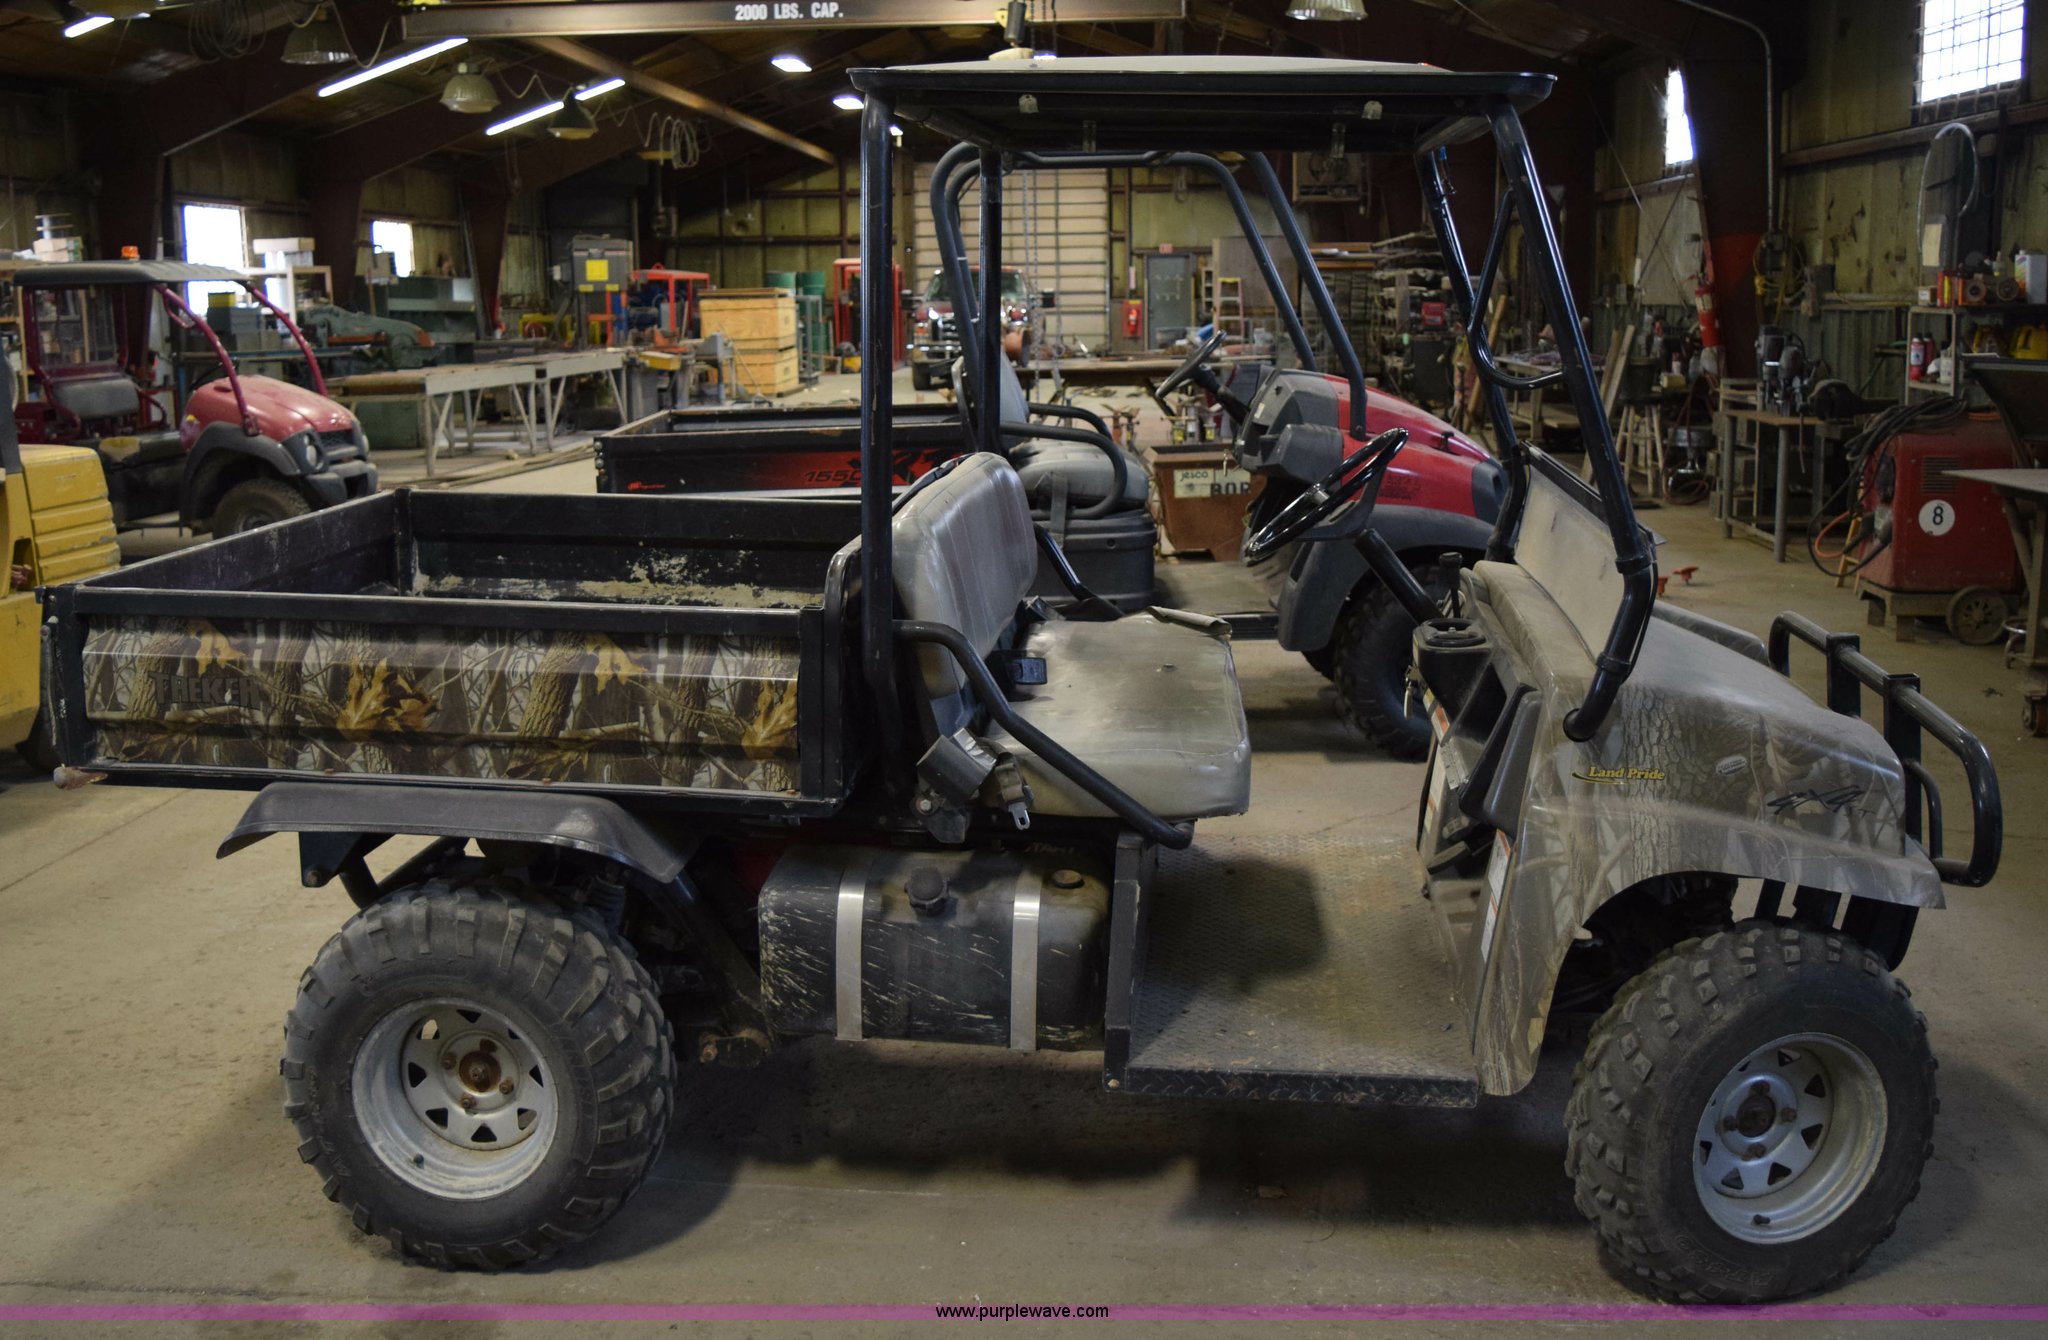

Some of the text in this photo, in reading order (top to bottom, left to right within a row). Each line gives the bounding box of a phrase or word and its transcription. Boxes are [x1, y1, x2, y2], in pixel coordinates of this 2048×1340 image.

[734, 1, 844, 21] 2000 LBS. CAP.
[1932, 505, 1944, 526] 8
[1588, 766, 1666, 781] Land Pride
